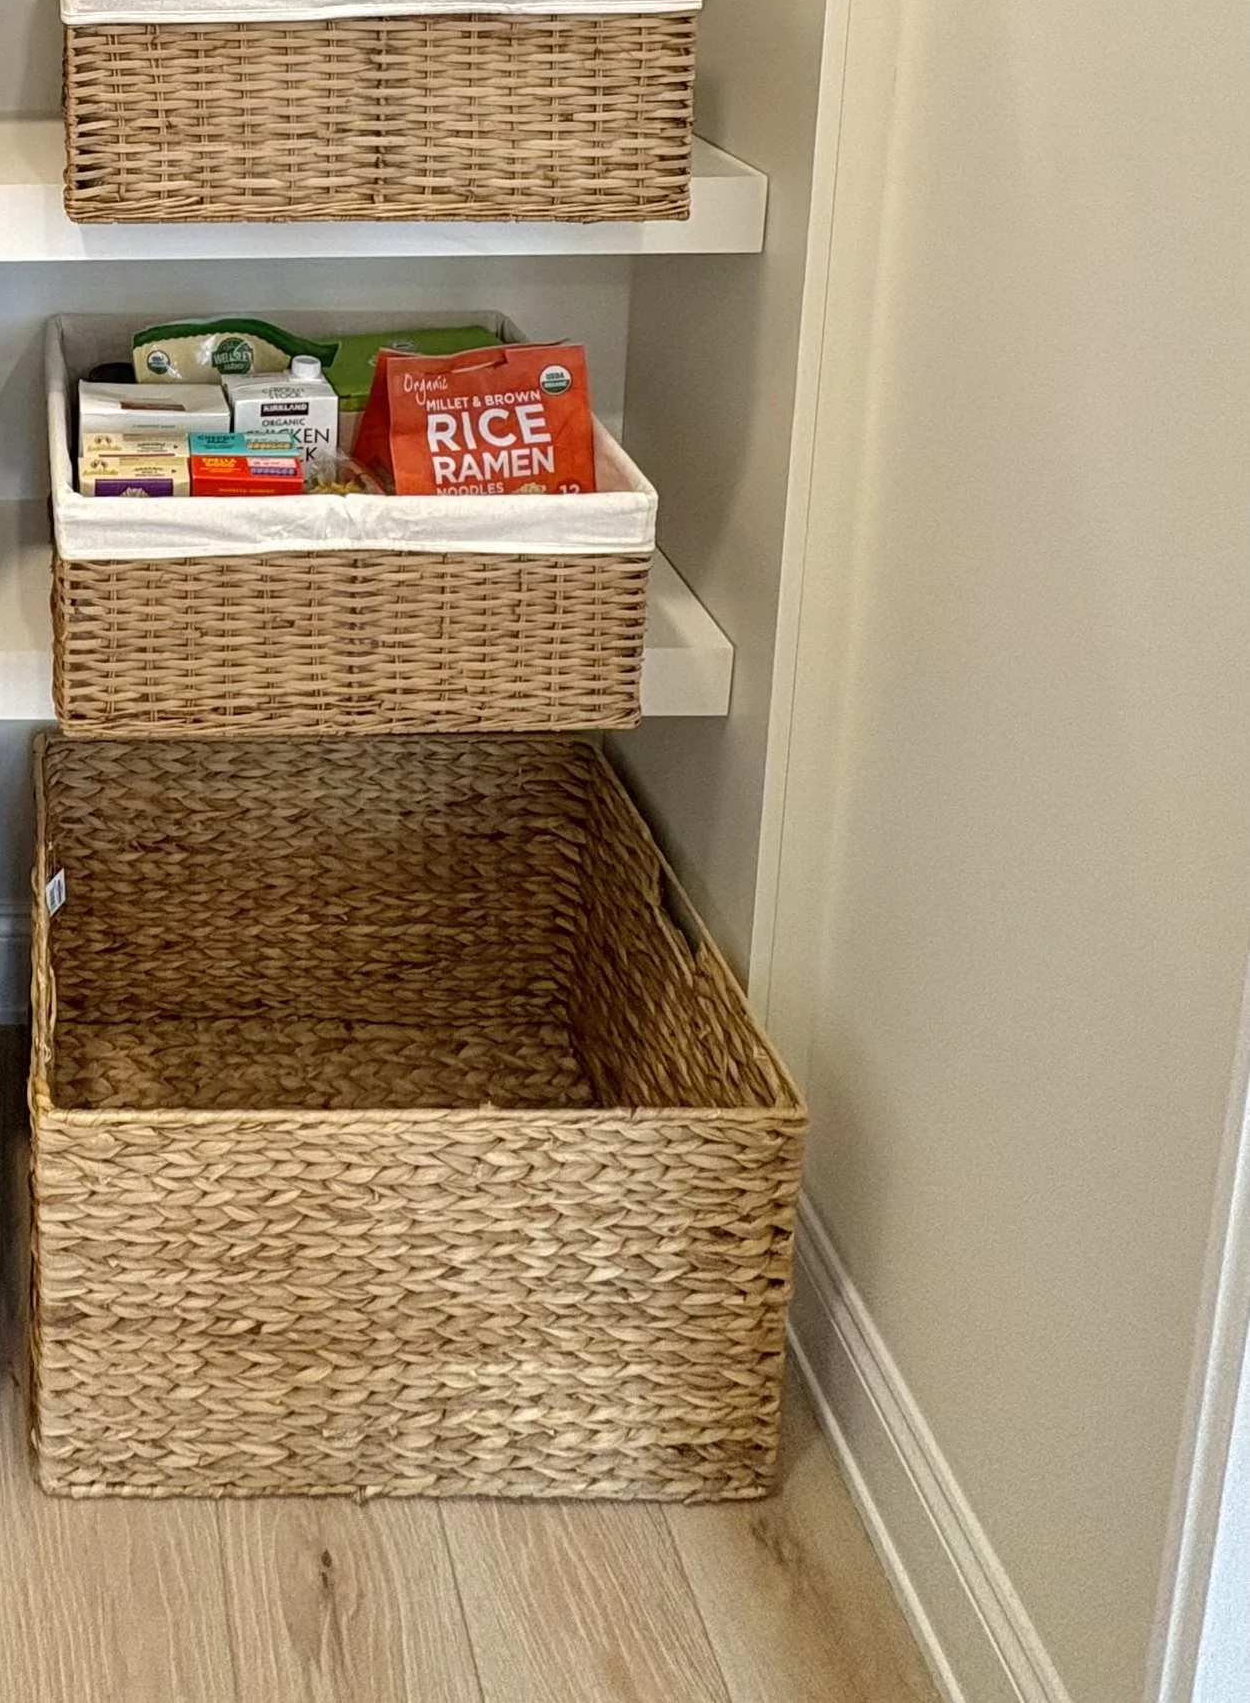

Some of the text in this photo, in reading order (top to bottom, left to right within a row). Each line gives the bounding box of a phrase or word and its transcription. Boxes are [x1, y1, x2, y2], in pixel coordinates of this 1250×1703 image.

[545, 372, 565, 380] USDA
[403, 373, 449, 406] Organic
[263, 404, 307, 412] KIRKLAND
[426, 389, 542, 412] MILLET & BROWN
[261, 418, 306, 427] ORGANIC
[427, 403, 552, 453] RICE
[432, 446, 556, 485] RAMEN
[436, 481, 505, 496] NOODLES
